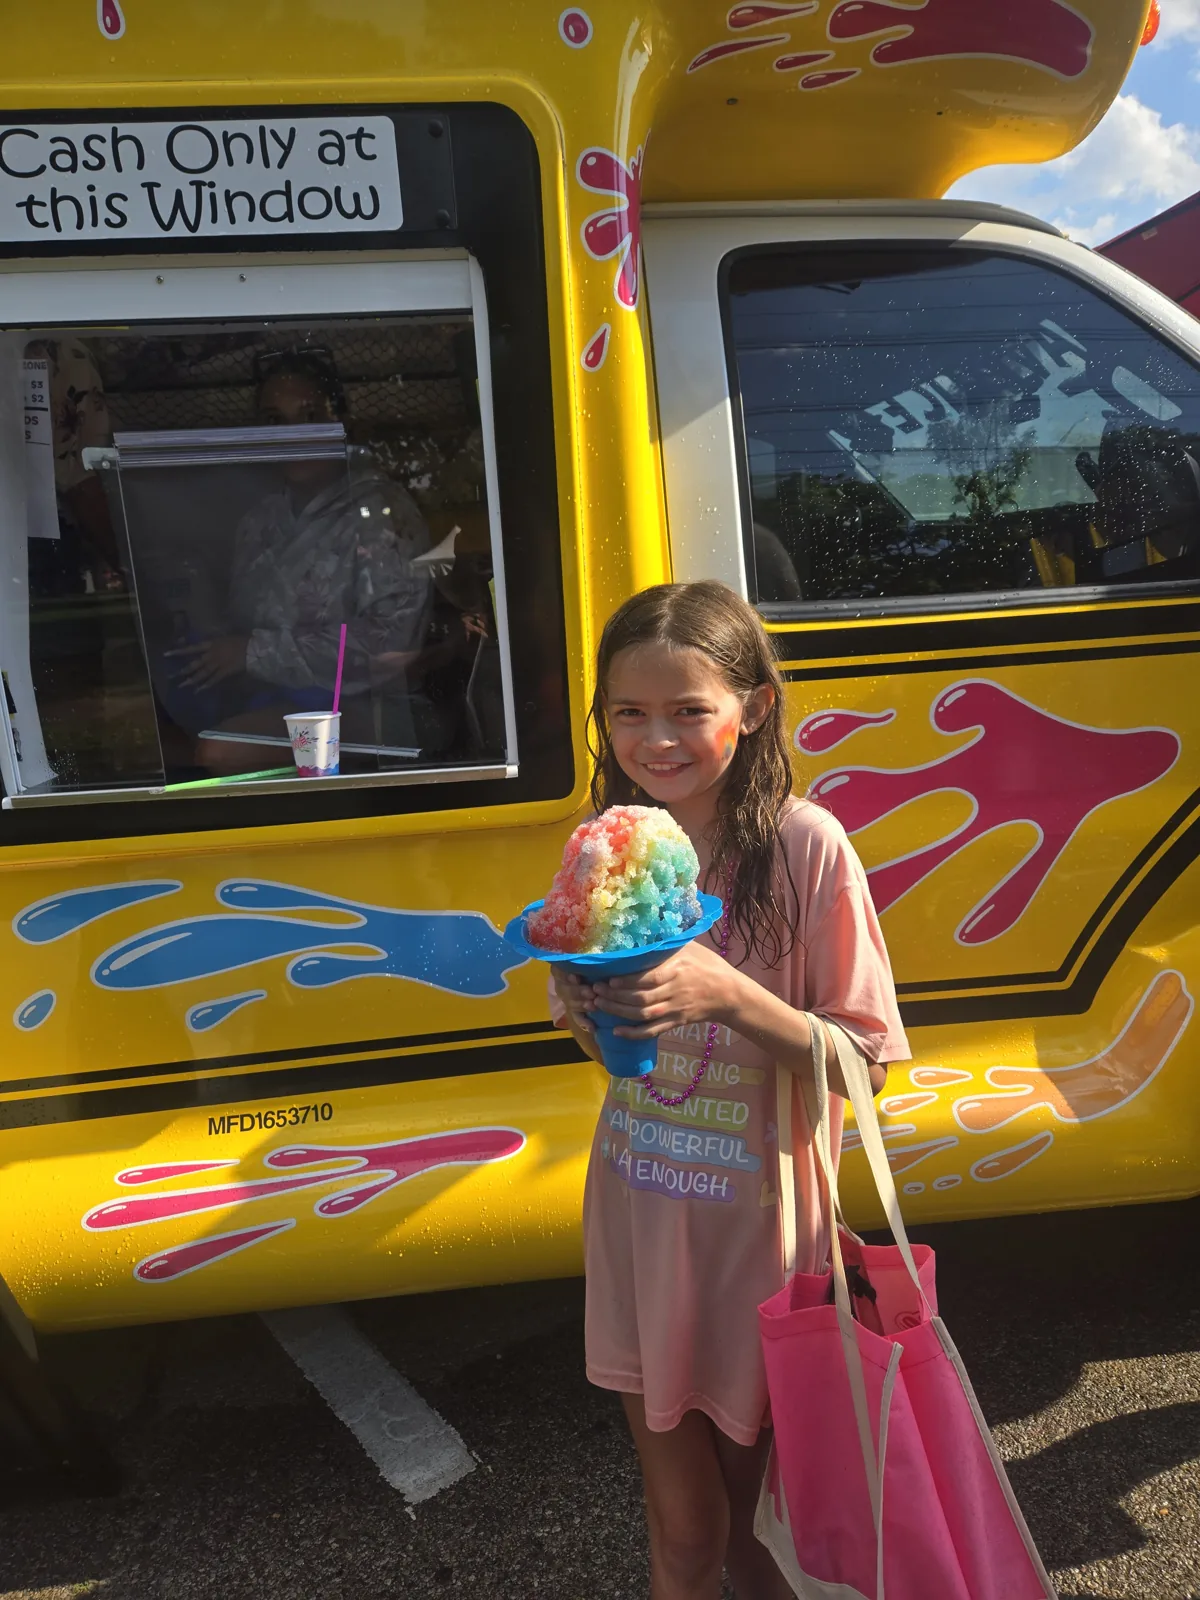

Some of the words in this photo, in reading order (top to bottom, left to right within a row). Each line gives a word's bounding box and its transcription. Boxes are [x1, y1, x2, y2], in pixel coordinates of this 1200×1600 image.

[0, 125, 145, 179] Cash
[166, 124, 296, 174] Only
[317, 126, 377, 167] at
[15, 184, 129, 232] this
[141, 179, 380, 233] Window
[23, 362, 47, 370] ONE
[31, 394, 44, 403] $2
[660, 1022, 732, 1046] MART
[655, 1052, 740, 1085] TRONG
[208, 1103, 333, 1135] MFD1653710
[635, 1083, 749, 1125] TALENTED
[629, 1117, 749, 1163] POWERFUL
[636, 1159, 729, 1197] ENOUGH
